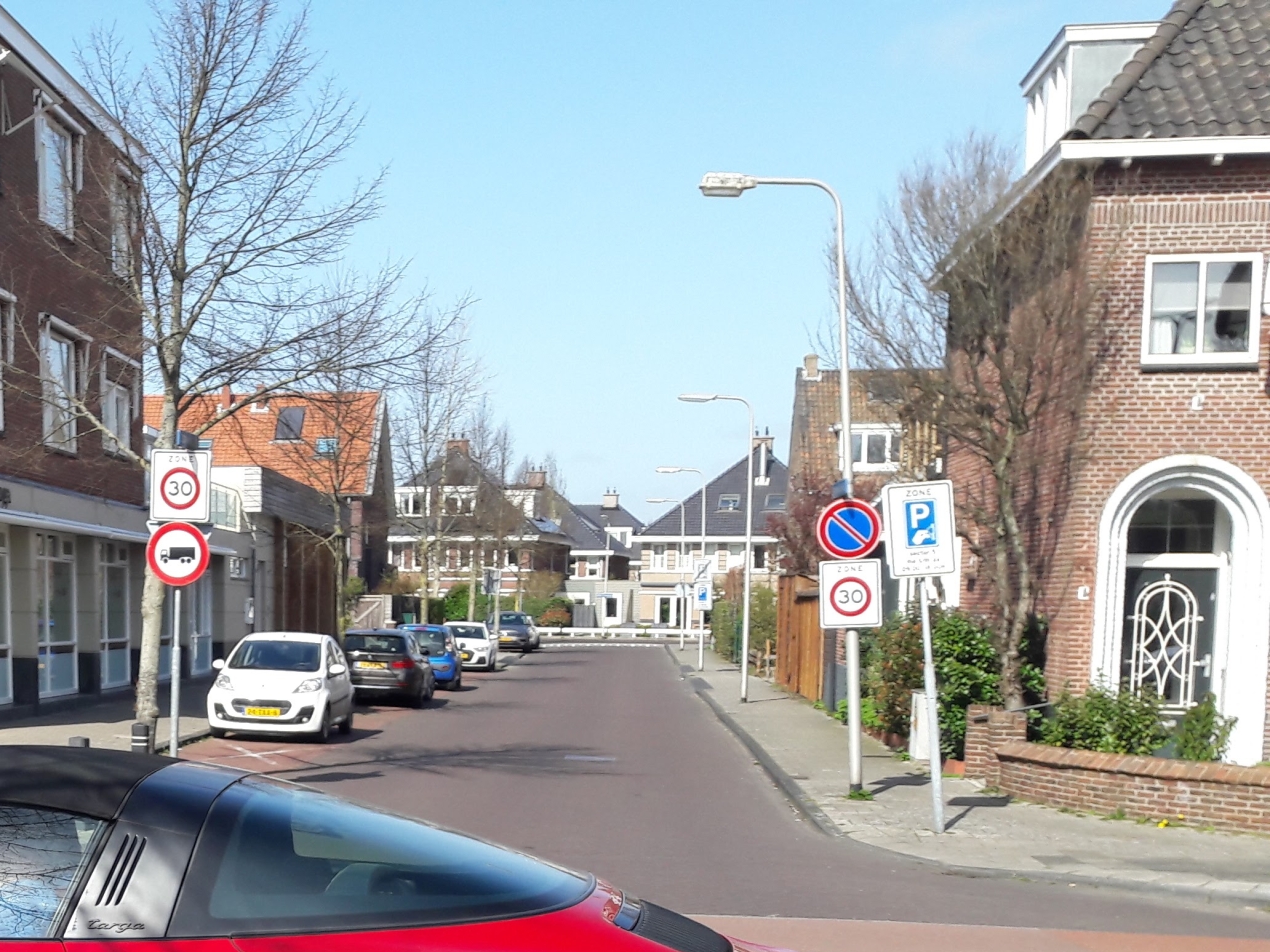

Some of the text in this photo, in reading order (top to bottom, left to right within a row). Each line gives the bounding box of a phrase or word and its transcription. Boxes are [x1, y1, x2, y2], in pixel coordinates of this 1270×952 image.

[168, 455, 195, 463] ZONE
[168, 480, 193, 496] 30
[905, 488, 932, 497] ZONE
[910, 503, 930, 529] P
[837, 565, 863, 573] ZONE
[838, 589, 863, 604] 30
